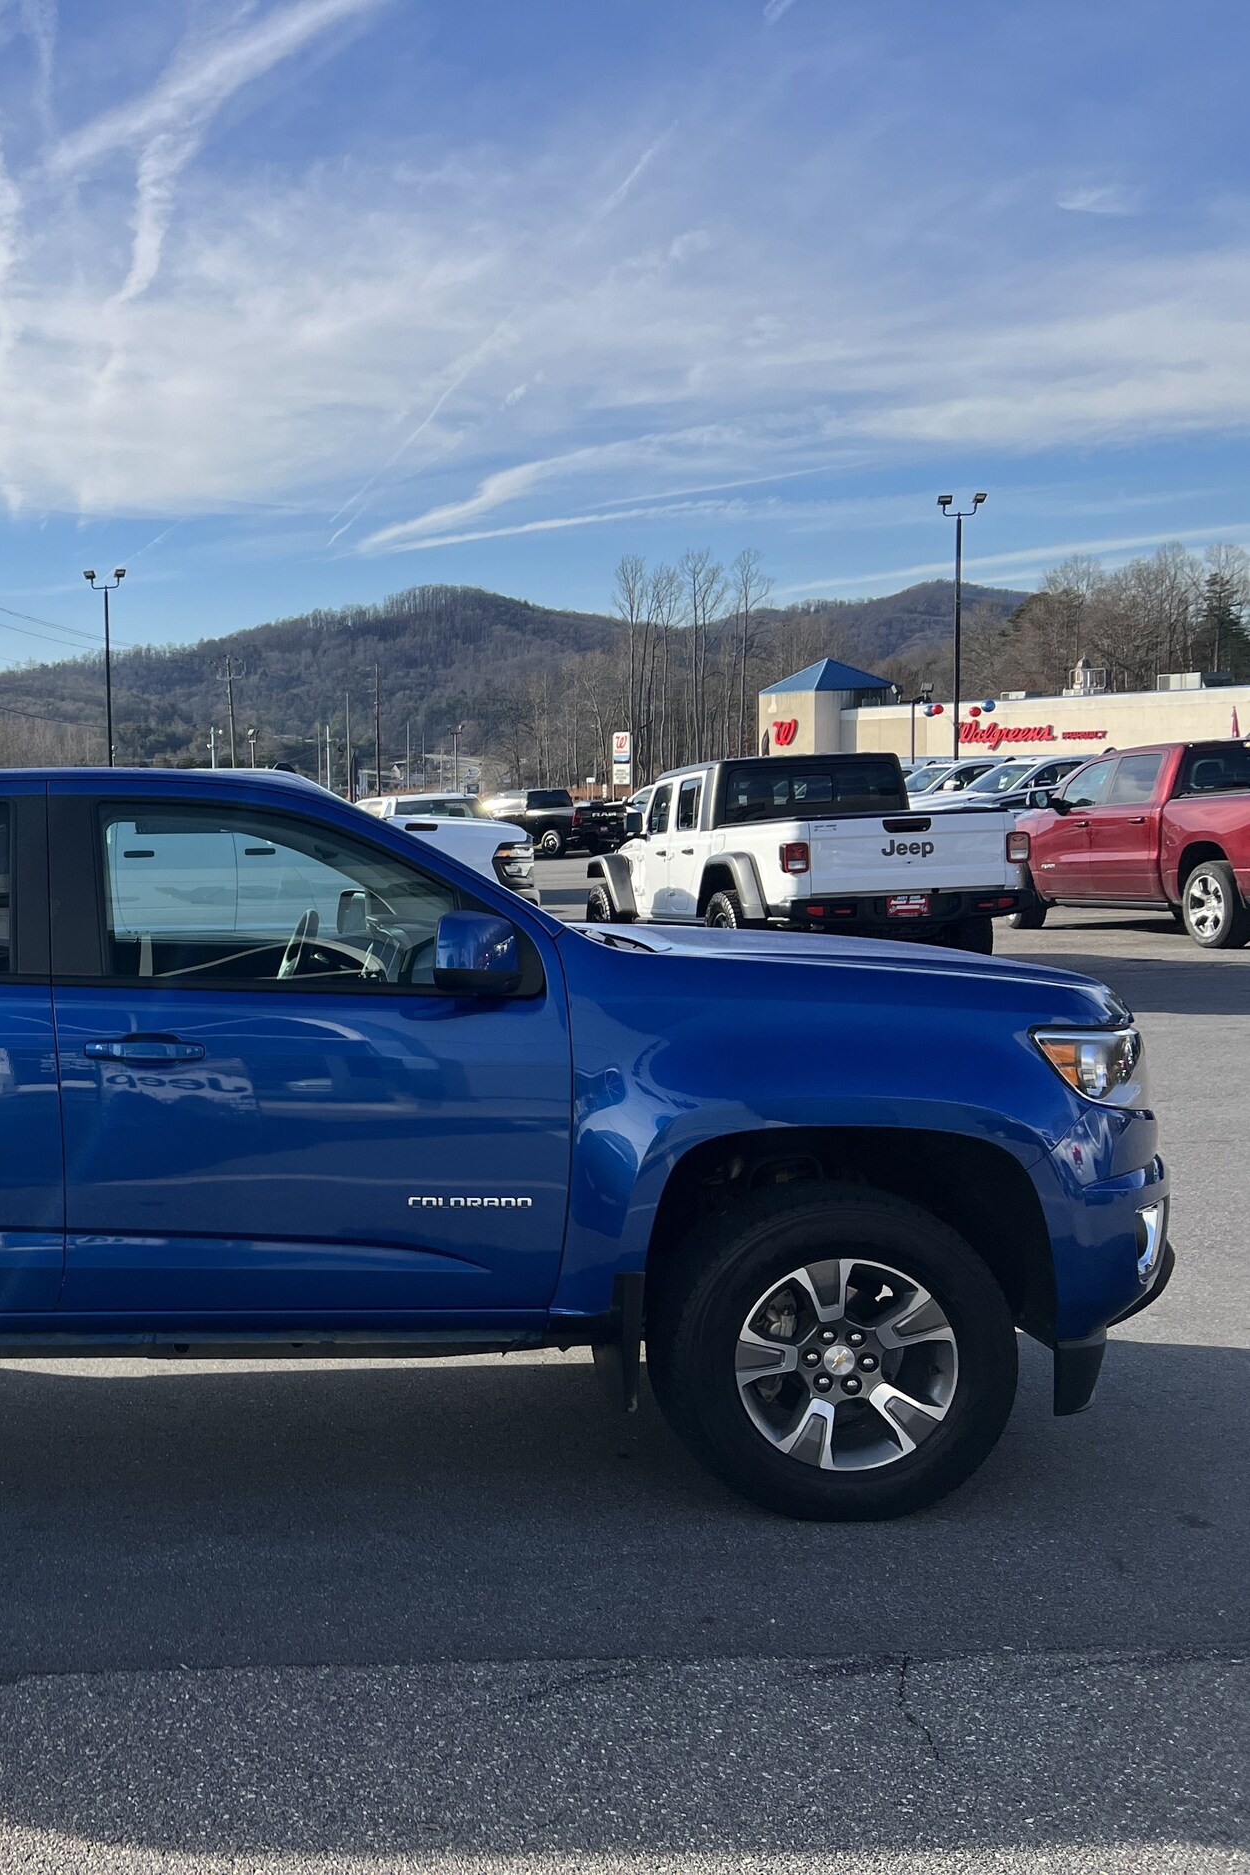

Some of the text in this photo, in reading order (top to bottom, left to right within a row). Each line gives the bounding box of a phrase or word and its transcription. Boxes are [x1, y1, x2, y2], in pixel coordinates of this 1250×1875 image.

[773, 718, 799, 746] W
[958, 719, 1057, 751] Walgreens
[881, 839, 935, 858] Jeep
[407, 1195, 533, 1210] COLORADO
